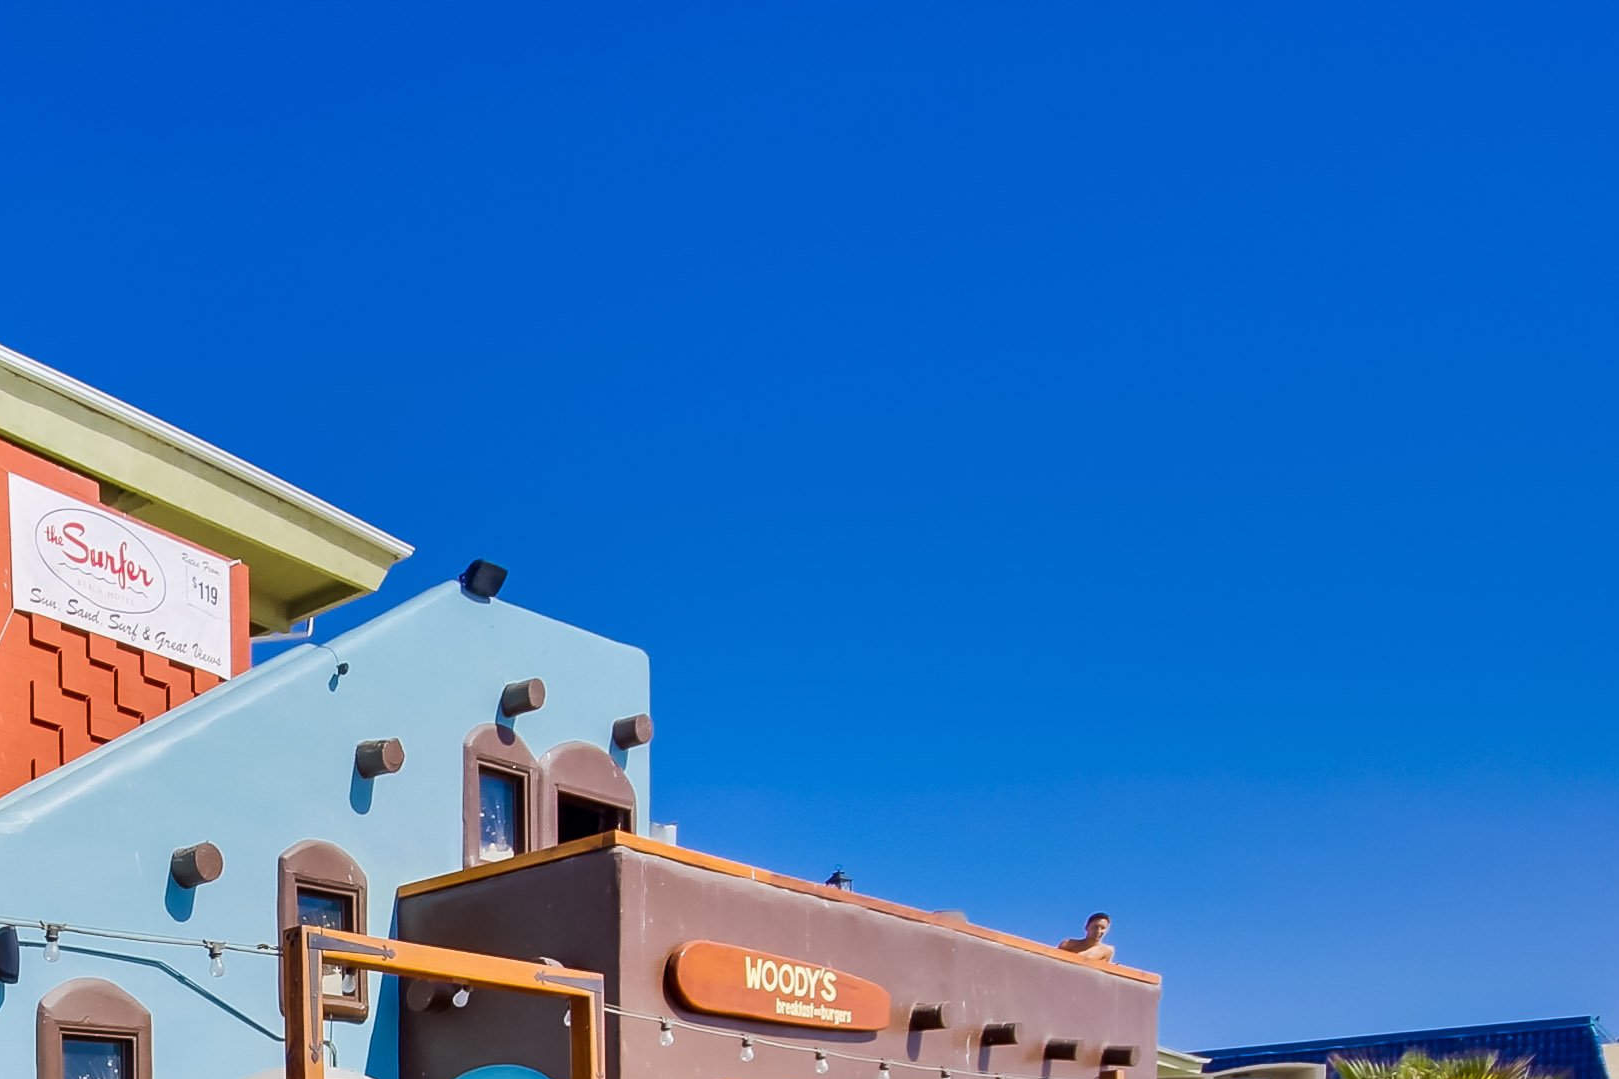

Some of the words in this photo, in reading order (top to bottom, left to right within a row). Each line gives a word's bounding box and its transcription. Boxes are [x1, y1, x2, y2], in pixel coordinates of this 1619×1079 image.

[44, 525, 64, 547] the
[62, 522, 154, 590] Surfer
[192, 576, 218, 606] $119
[108, 614, 139, 642] Surf
[142, 626, 151, 641] &
[155, 631, 188, 654] Great
[192, 643, 221, 667] Views
[745, 956, 837, 1002] WOODY'S
